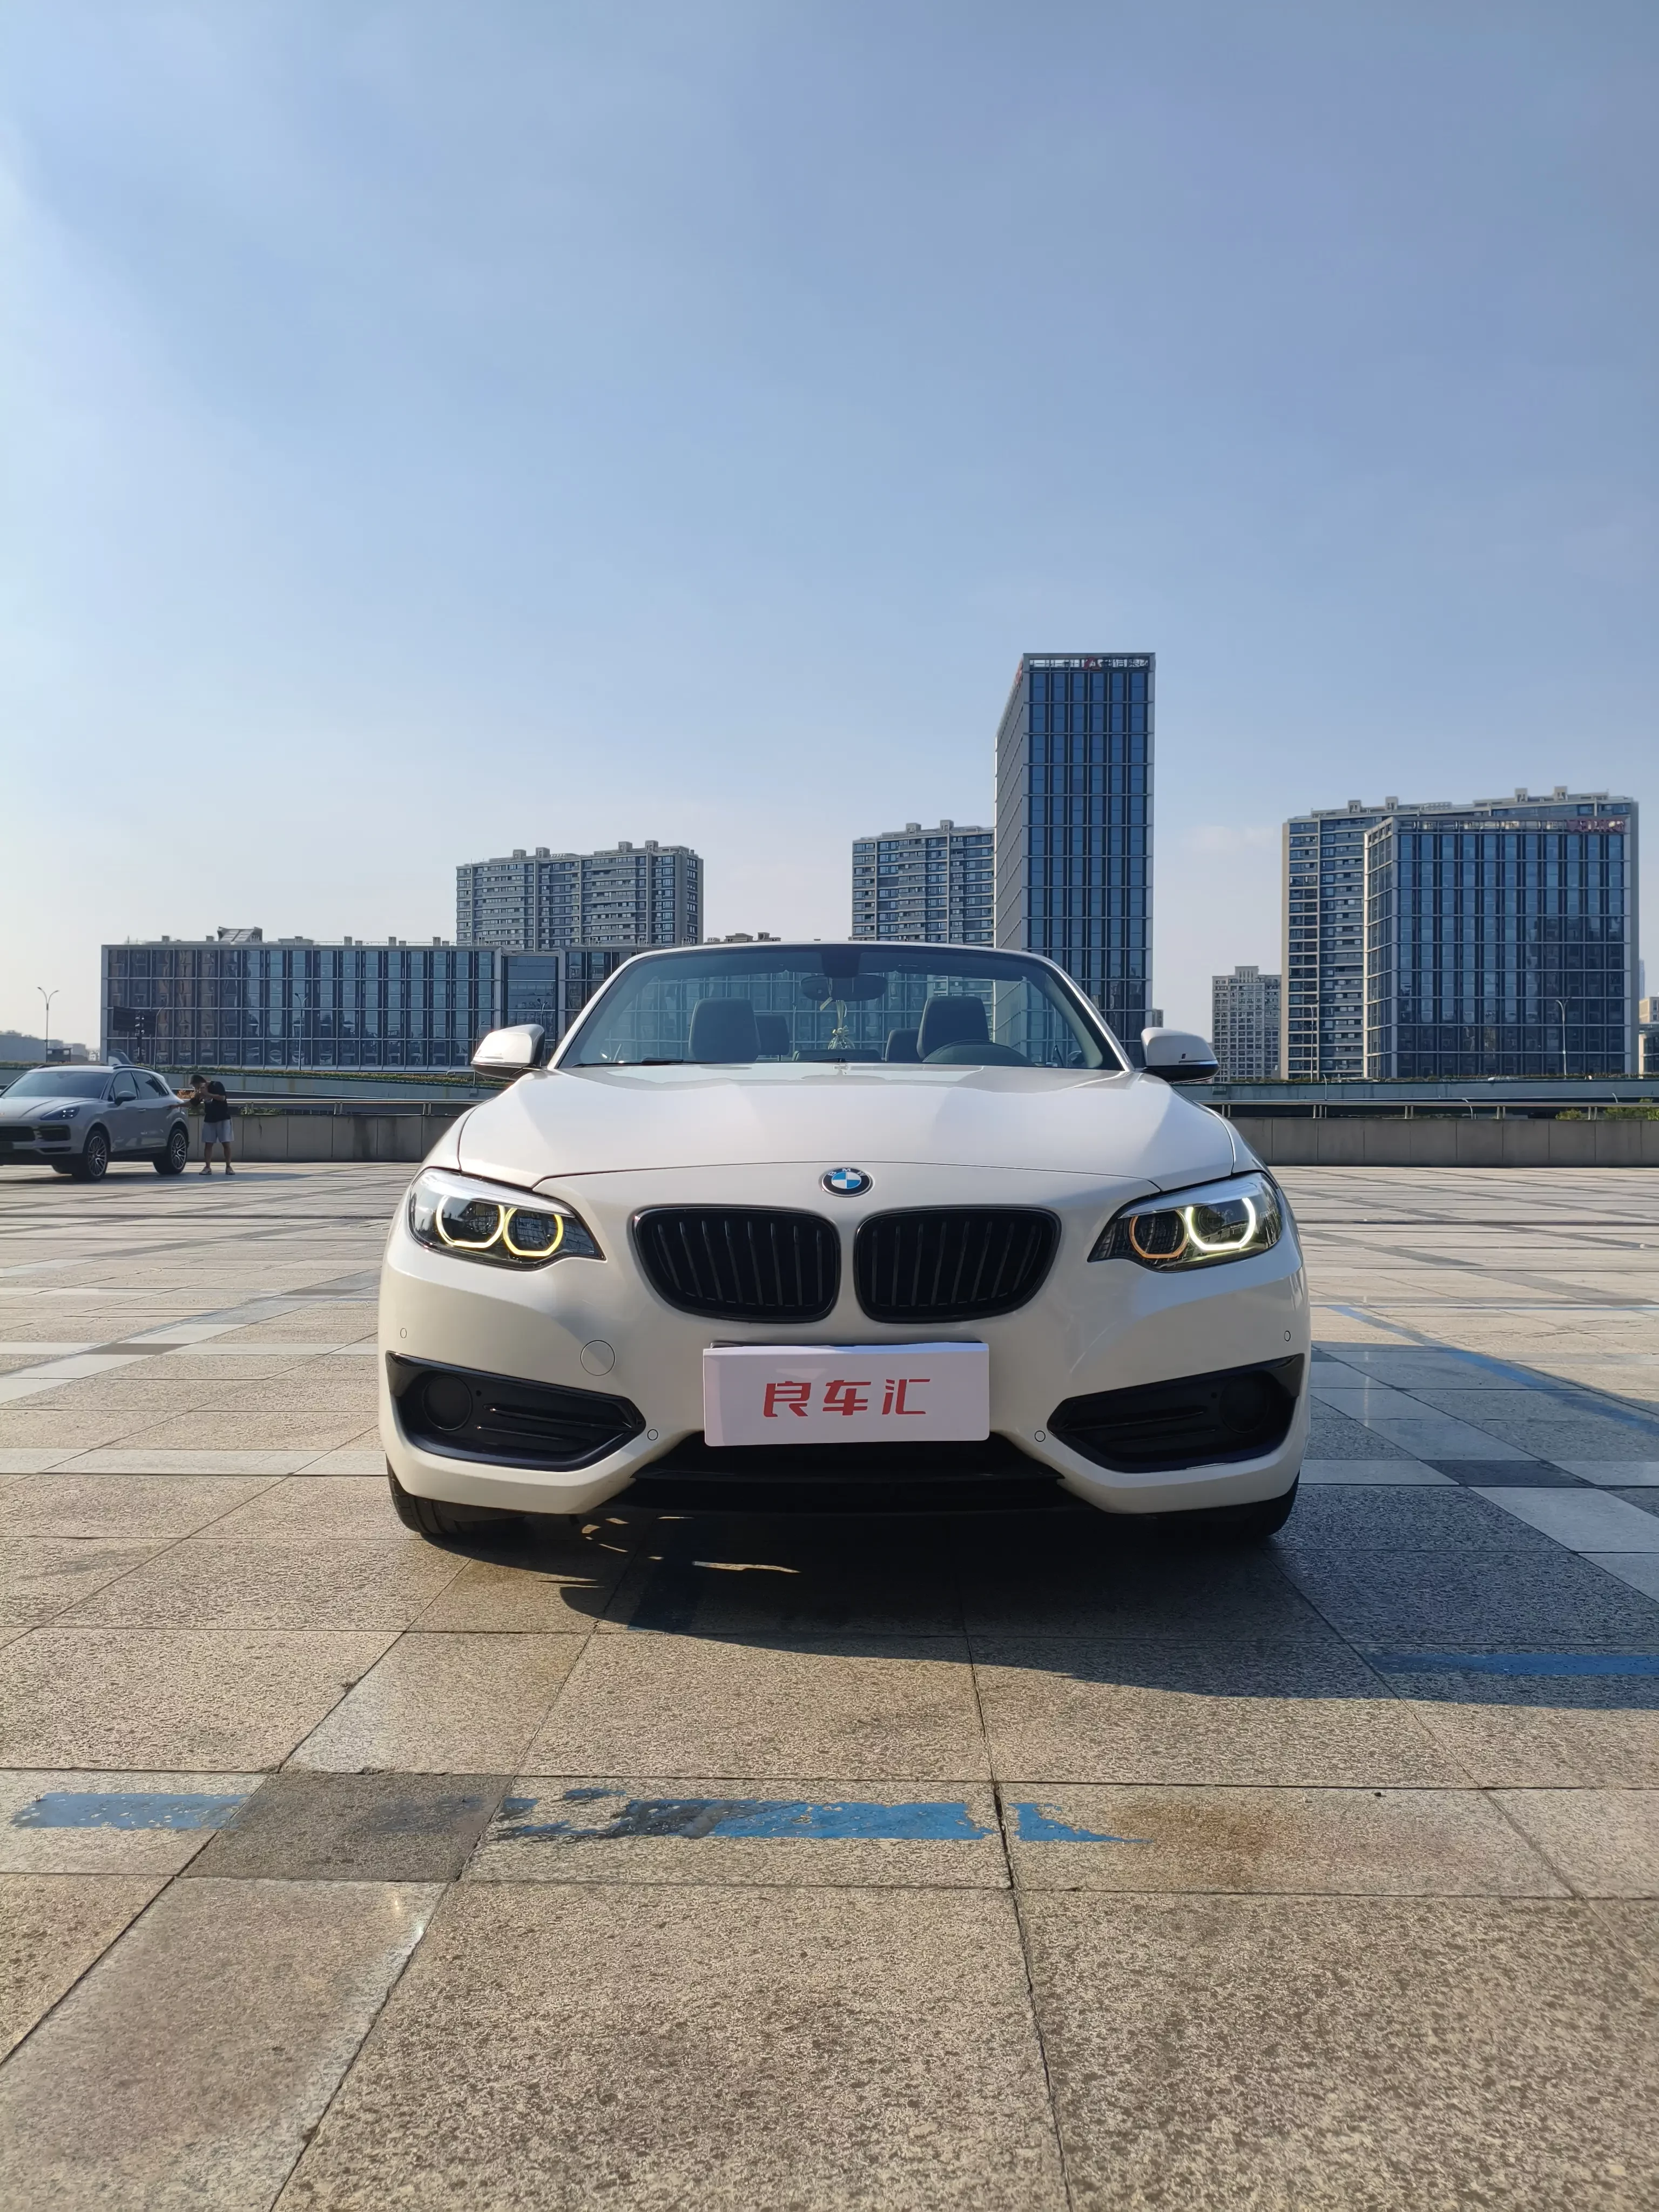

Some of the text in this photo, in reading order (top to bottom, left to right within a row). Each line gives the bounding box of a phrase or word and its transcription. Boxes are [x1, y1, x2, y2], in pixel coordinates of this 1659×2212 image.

[827, 1168, 866, 1176] BMW
[763, 1378, 930, 1418] 良车汇
